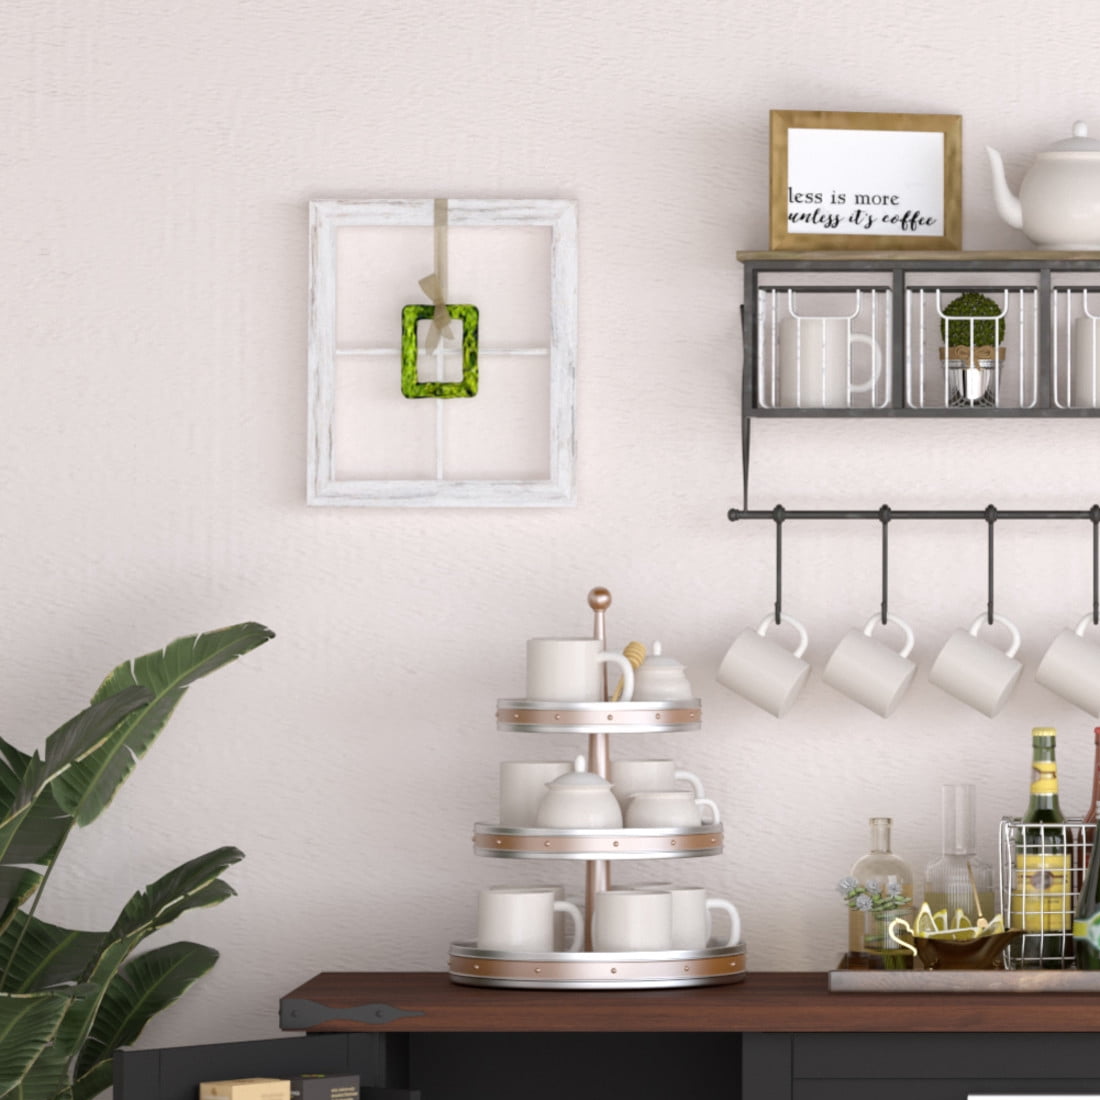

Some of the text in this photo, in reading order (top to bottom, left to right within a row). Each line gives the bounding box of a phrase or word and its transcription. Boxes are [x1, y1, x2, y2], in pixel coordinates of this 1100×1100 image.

[788, 187, 899, 205] less is more
[787, 208, 937, 231] unless it's coffee
